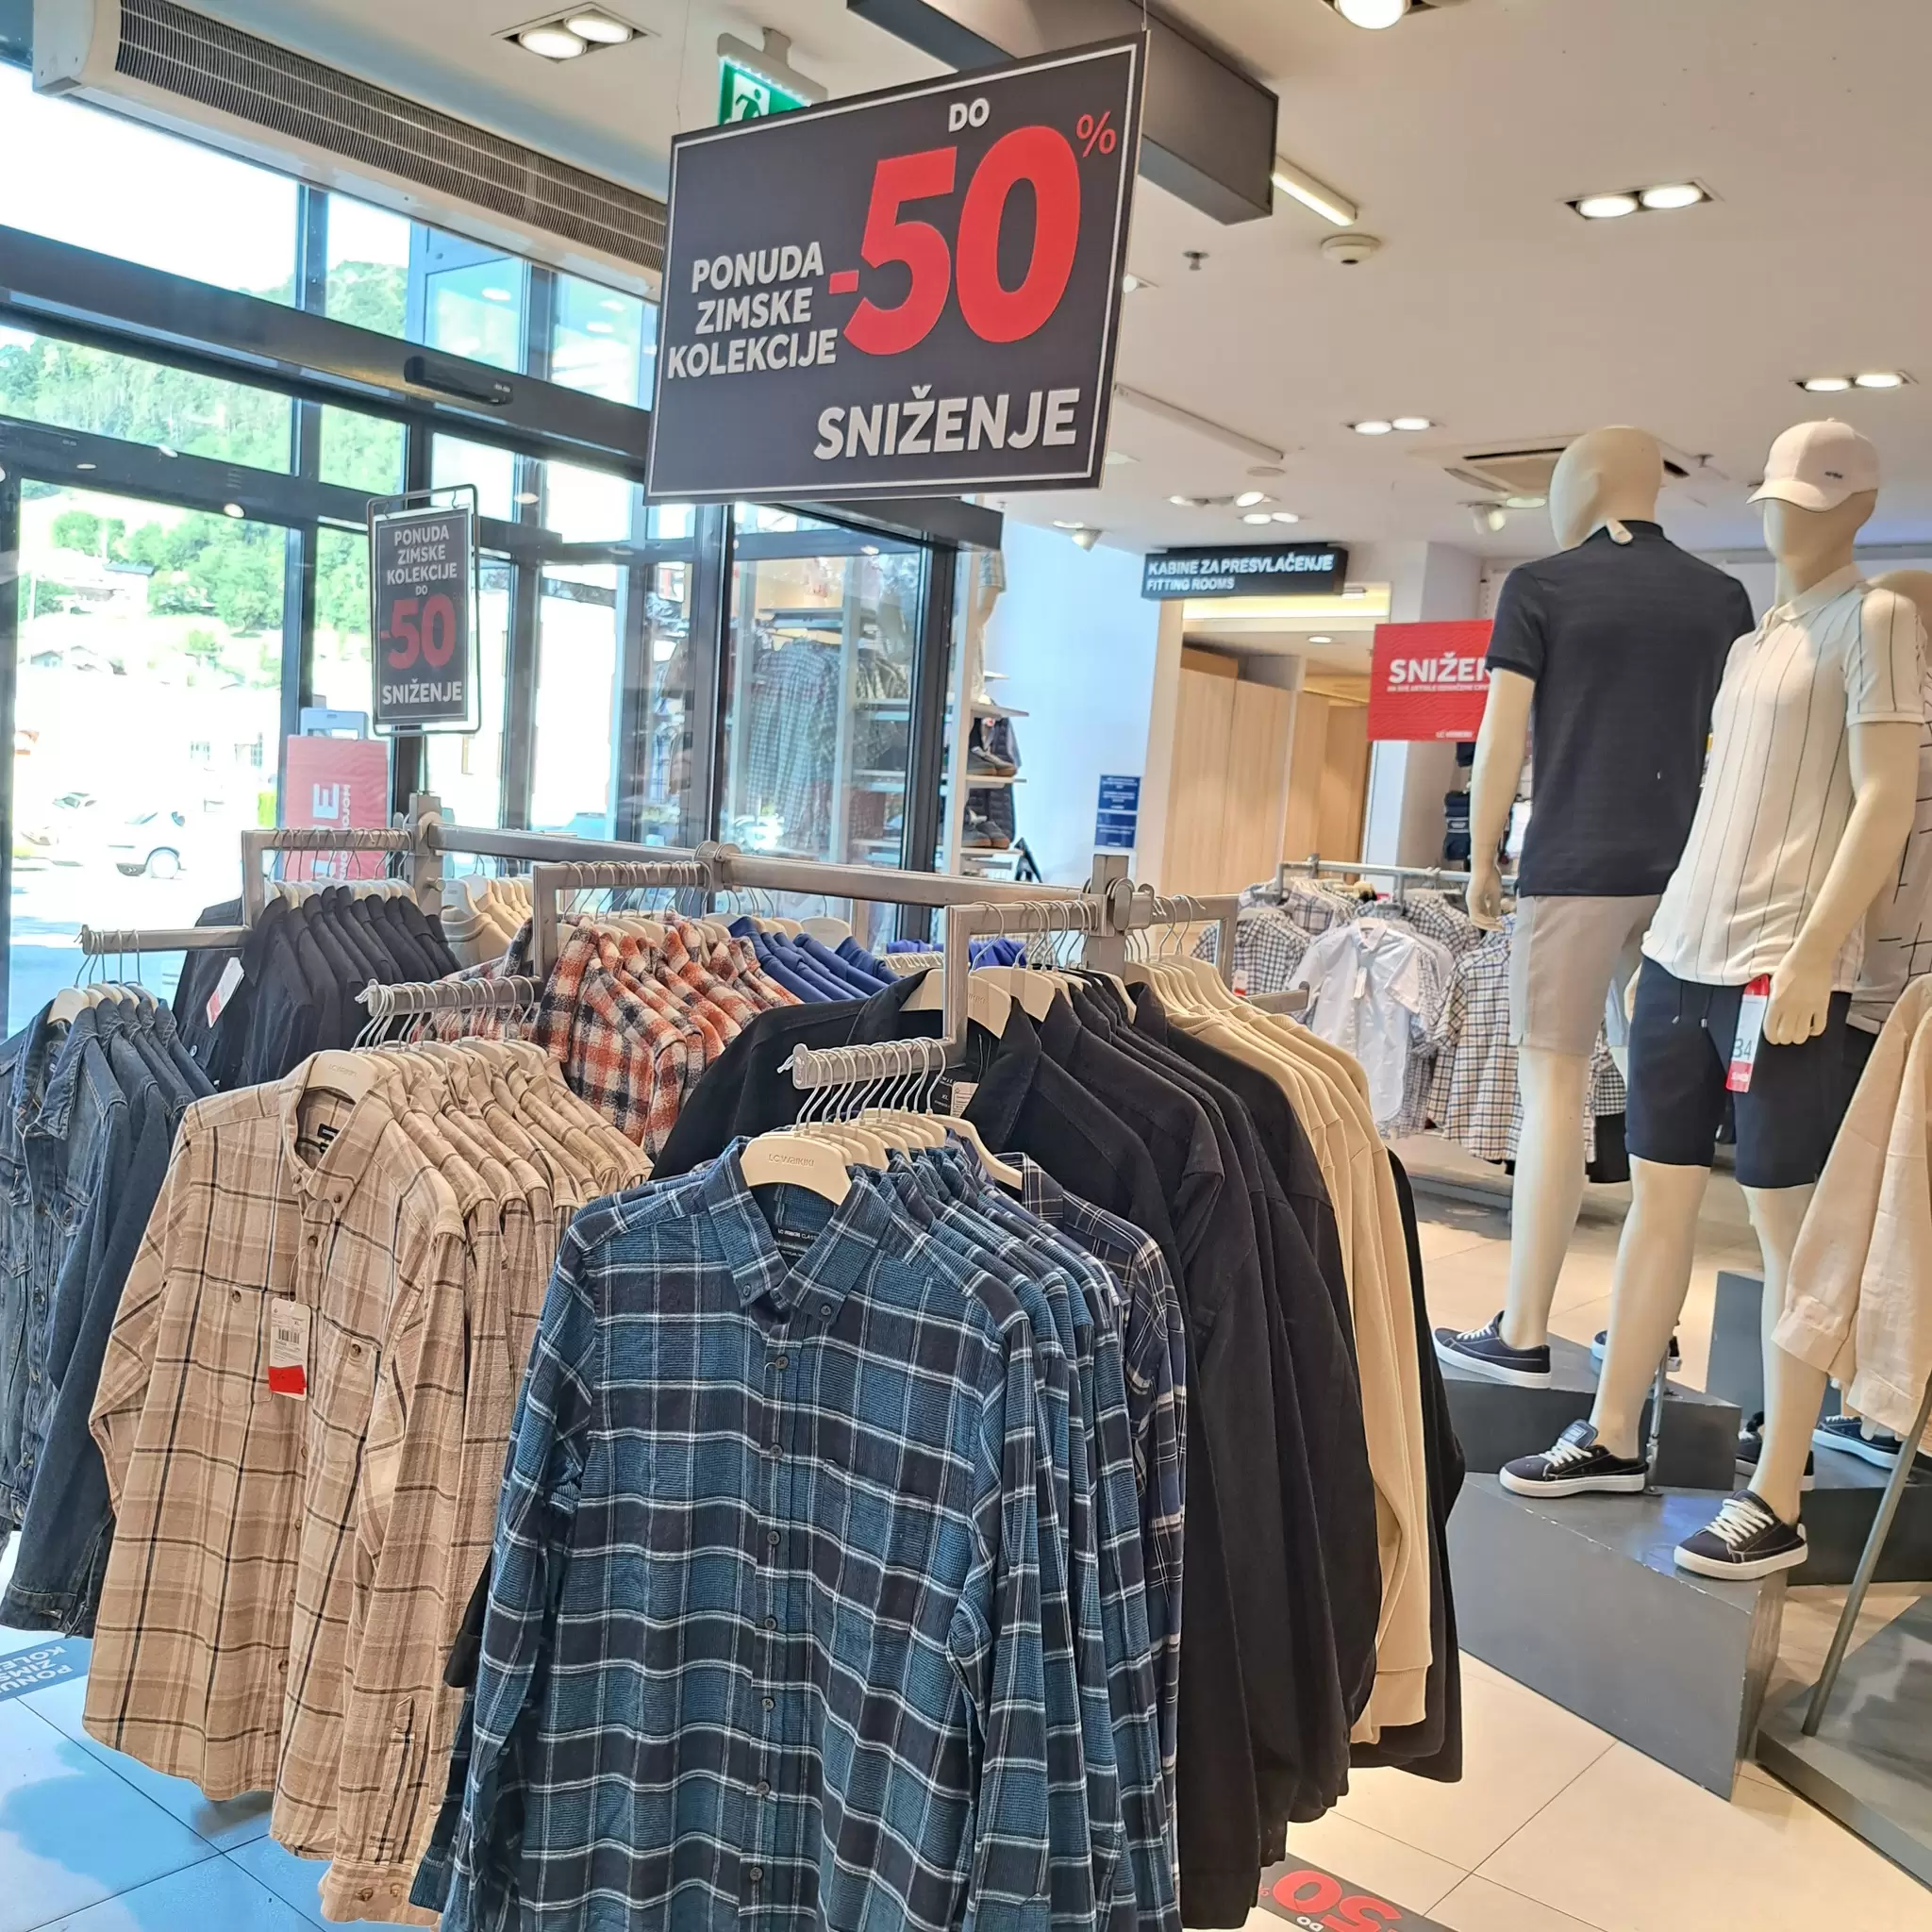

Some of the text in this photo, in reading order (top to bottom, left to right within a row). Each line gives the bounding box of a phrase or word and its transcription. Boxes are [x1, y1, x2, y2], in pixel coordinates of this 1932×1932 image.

[948, 98, 991, 132] DO
[691, 242, 824, 293] PONUDA
[695, 288, 813, 335] ZIMSKE
[667, 328, 838, 379] KOLEKCIJE
[813, 384, 1080, 460] SNIŽENJE
[394, 525, 449, 546] PONUDA
[397, 544, 446, 565] ZIMSKE
[1148, 551, 1334, 575] KABINE ZA PRESVLAČENJE
[387, 562, 458, 585] KOLEKCIJE
[1147, 575, 1235, 591] FITTING ROOMS
[415, 585, 428, 596] DO
[382, 678, 462, 705] SNIŽENJE
[0, 1646, 68, 1672] KOLE
[0, 1665, 74, 1693] PONU
[1296, 1916, 1324, 1932] DO
